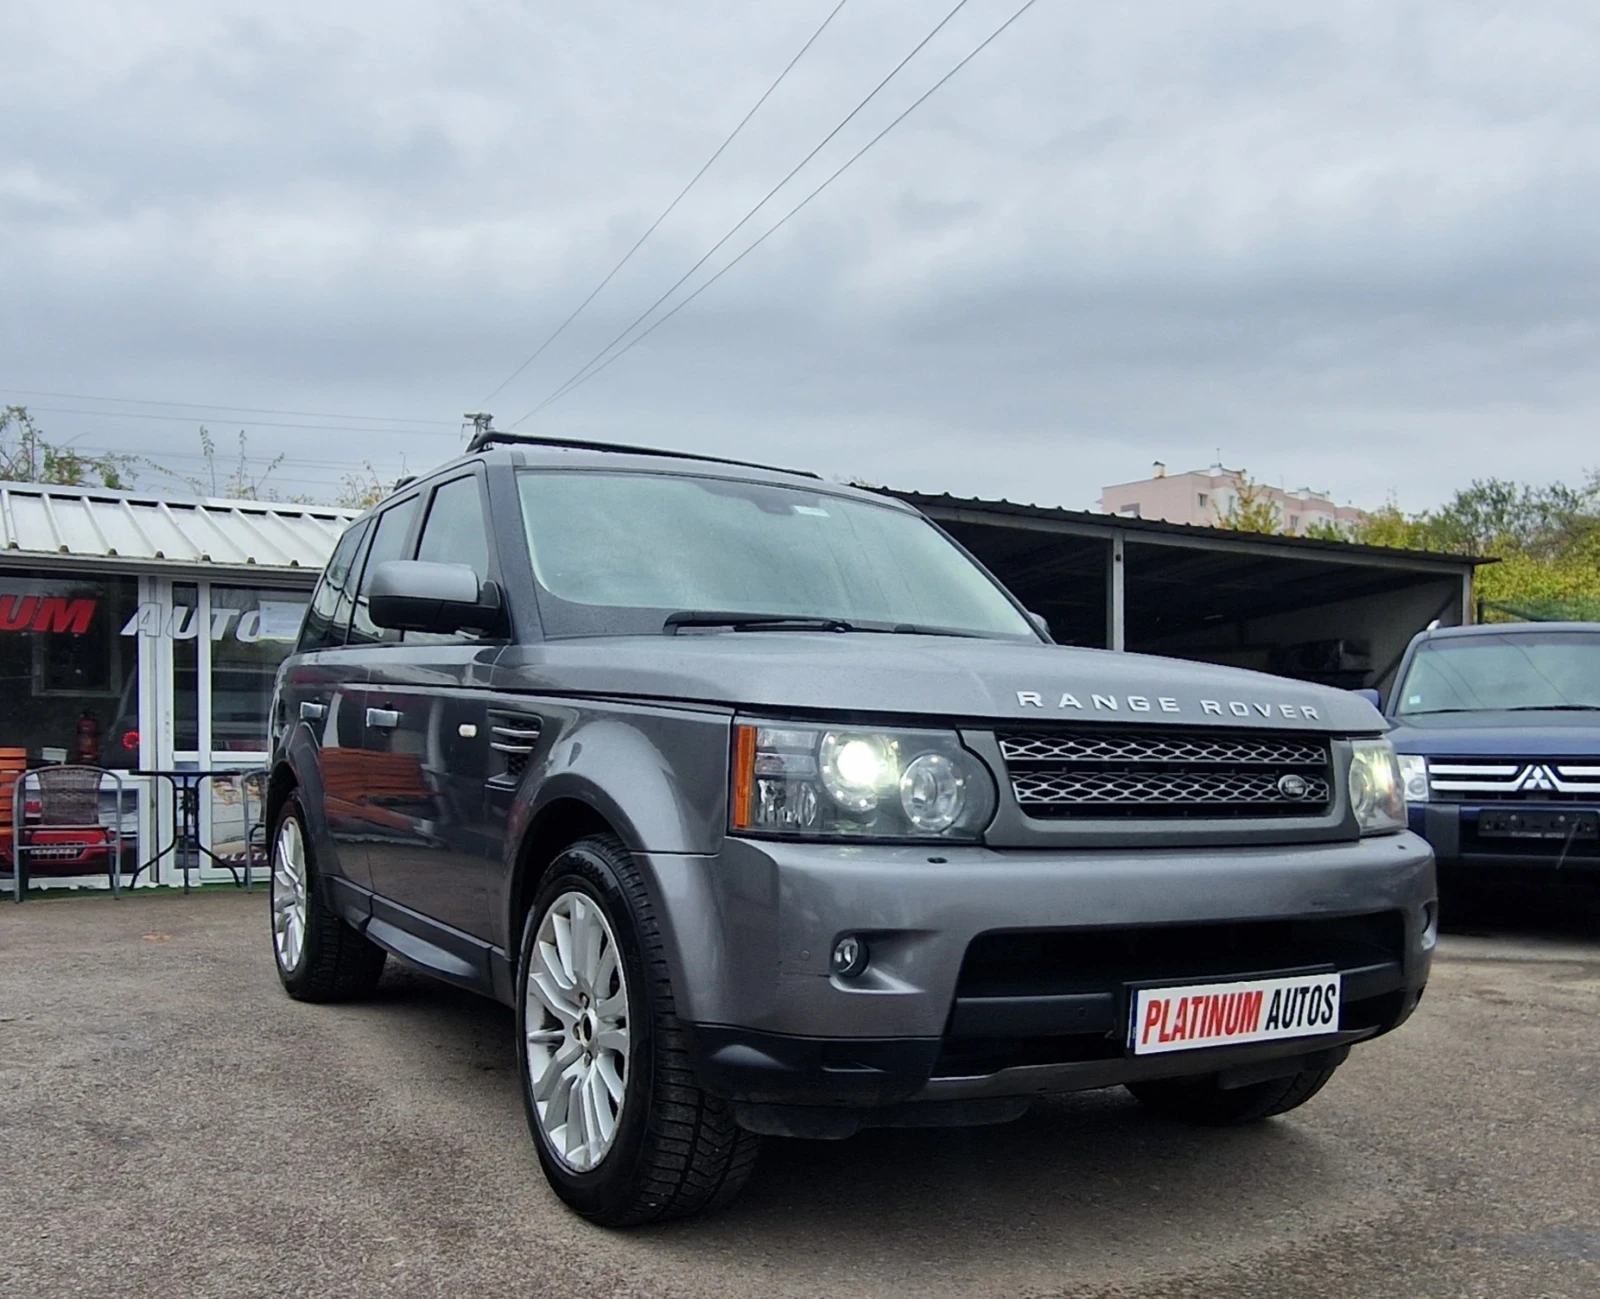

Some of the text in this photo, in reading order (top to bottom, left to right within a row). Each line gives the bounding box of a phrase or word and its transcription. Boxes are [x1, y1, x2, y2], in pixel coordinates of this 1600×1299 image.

[120, 602, 297, 644] AUTO
[1016, 690, 1321, 721] RANGE ROVER
[1141, 983, 1336, 1045] PLATINUM AUTOS
